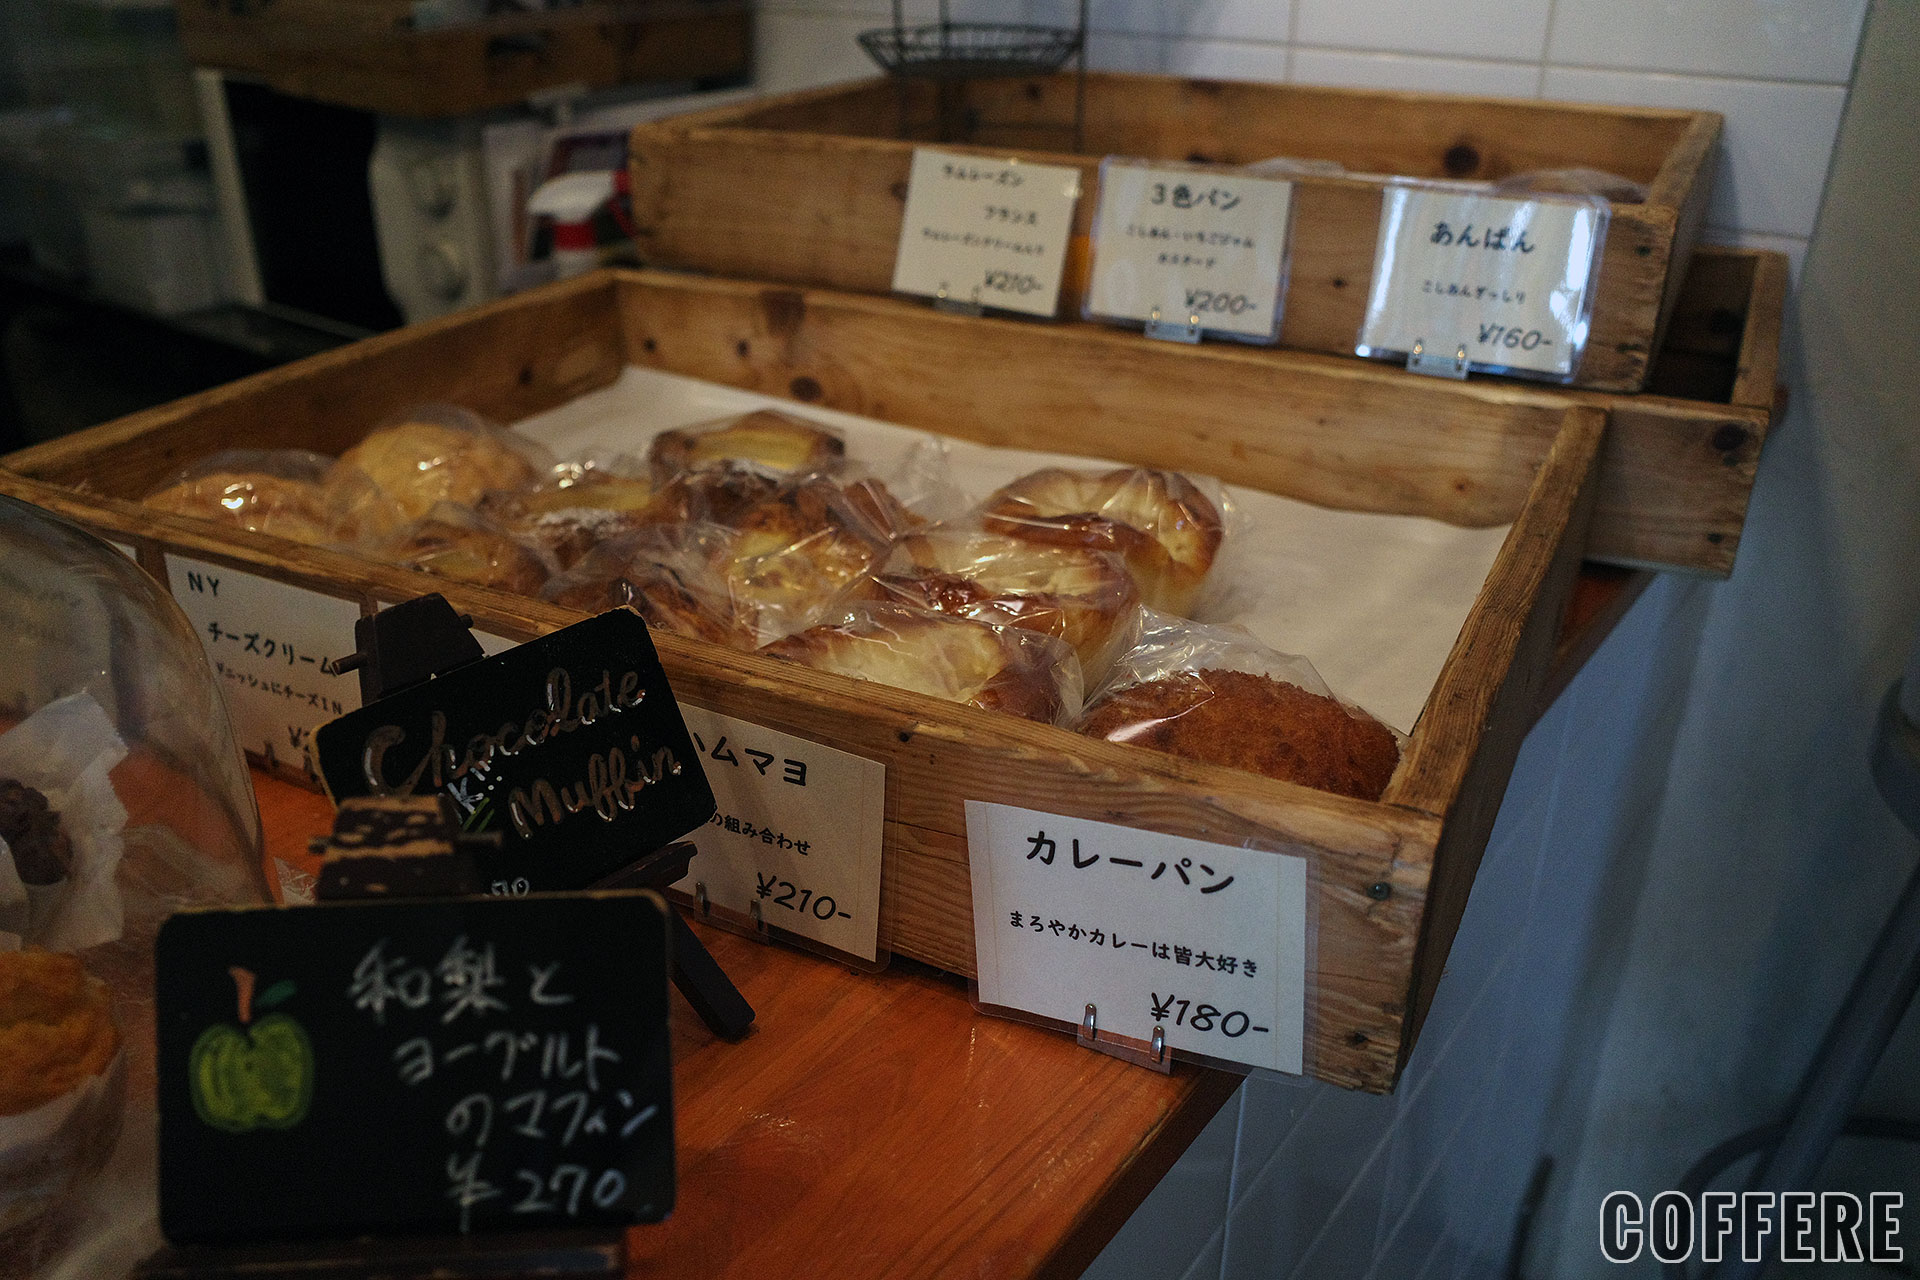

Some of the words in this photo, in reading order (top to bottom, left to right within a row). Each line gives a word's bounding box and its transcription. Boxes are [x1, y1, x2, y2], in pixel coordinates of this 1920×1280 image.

[1151, 183, 1241, 211] 3色パン
[187, 571, 220, 596] NY
[363, 666, 647, 797] Chocolate
[508, 734, 682, 839] Muffin
[1027, 830, 1234, 894] カレーパン
[756, 872, 851, 920] ¥210-
[1010, 911, 1257, 978] まろやかカレーは皆大好き
[1150, 993, 1269, 1037] ¥180-
[395, 1024, 619, 1092] ヨーグルト
[445, 1090, 656, 1146] のマフィン
